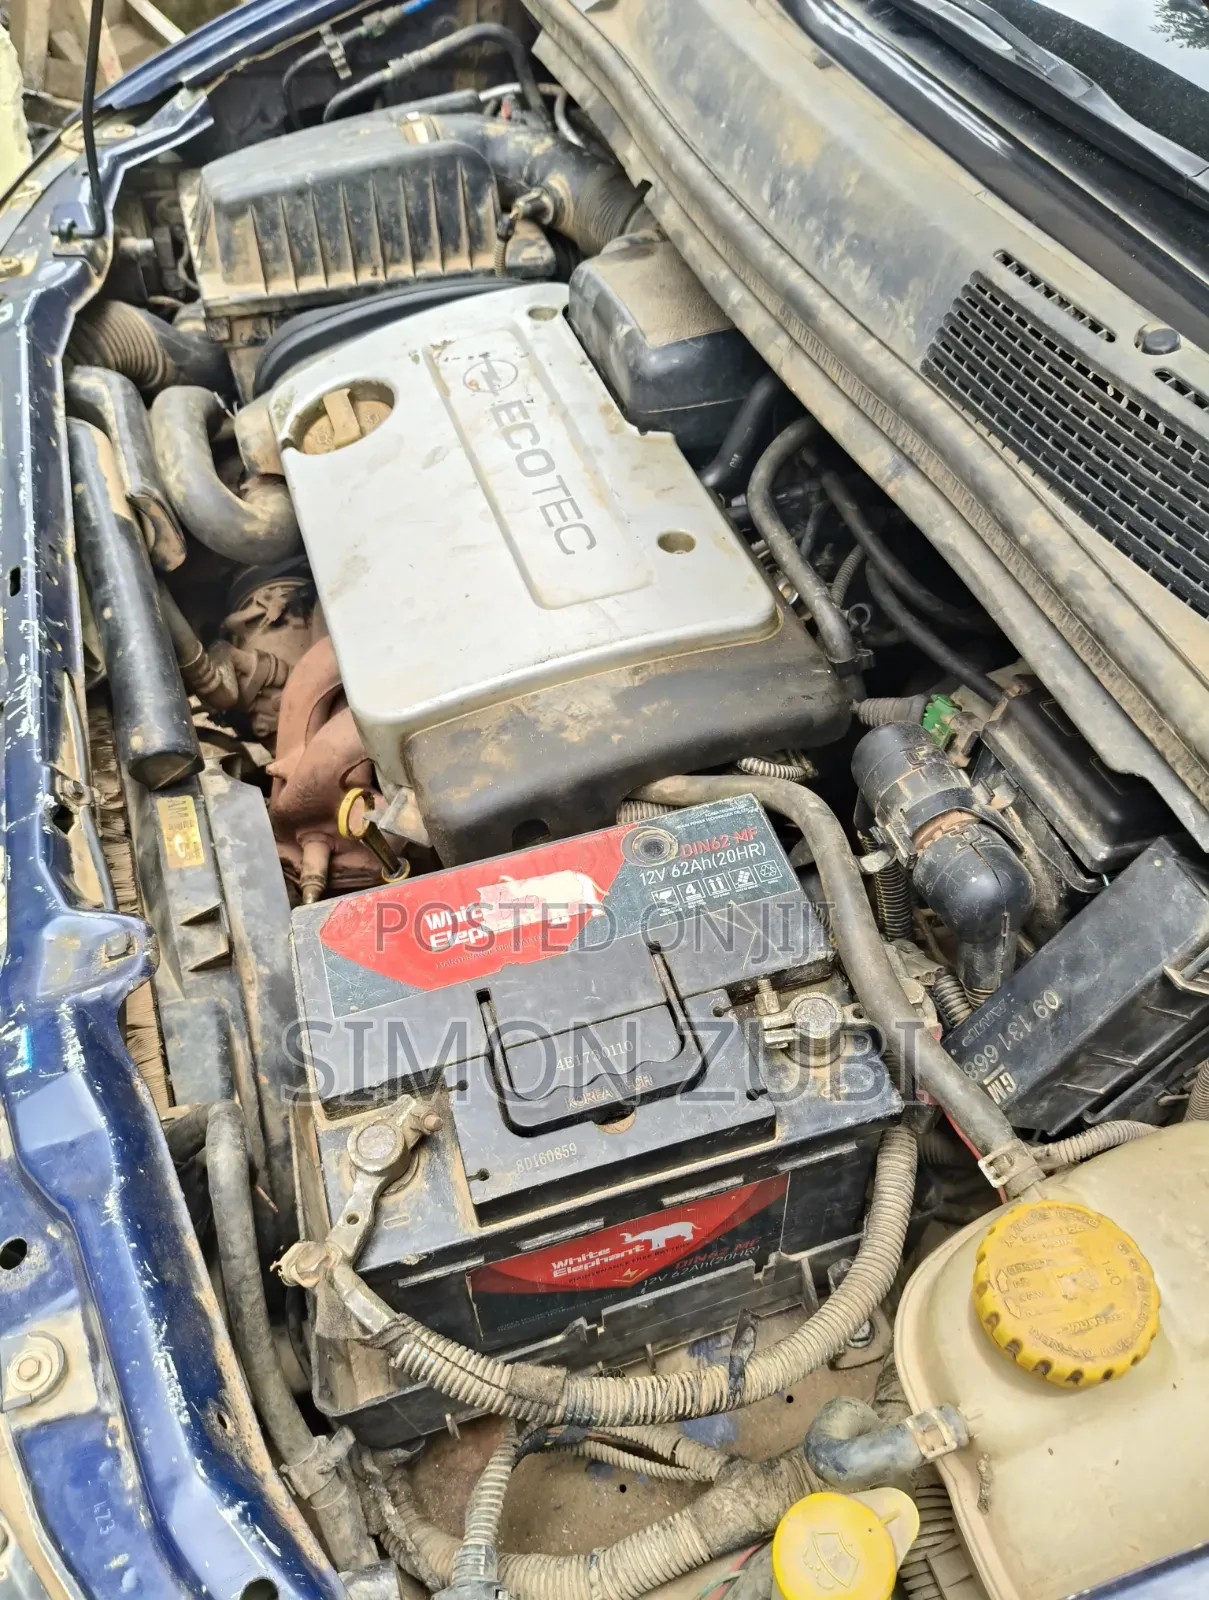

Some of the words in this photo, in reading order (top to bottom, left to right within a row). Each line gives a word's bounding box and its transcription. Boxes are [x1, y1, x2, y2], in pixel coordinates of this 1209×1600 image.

[490, 399, 597, 555] ECOTEC
[680, 834, 731, 858] DIN62
[732, 826, 758, 843] MF
[640, 868, 667, 887] 12V
[671, 841, 767, 879] 62Ah(20HR)
[565, 1087, 613, 1109] KOREA
[986, 1071, 1017, 1105] GM
[551, 1247, 611, 1270] White
[553, 1245, 645, 1278] Elephant
[643, 1273, 668, 1288] 12V
